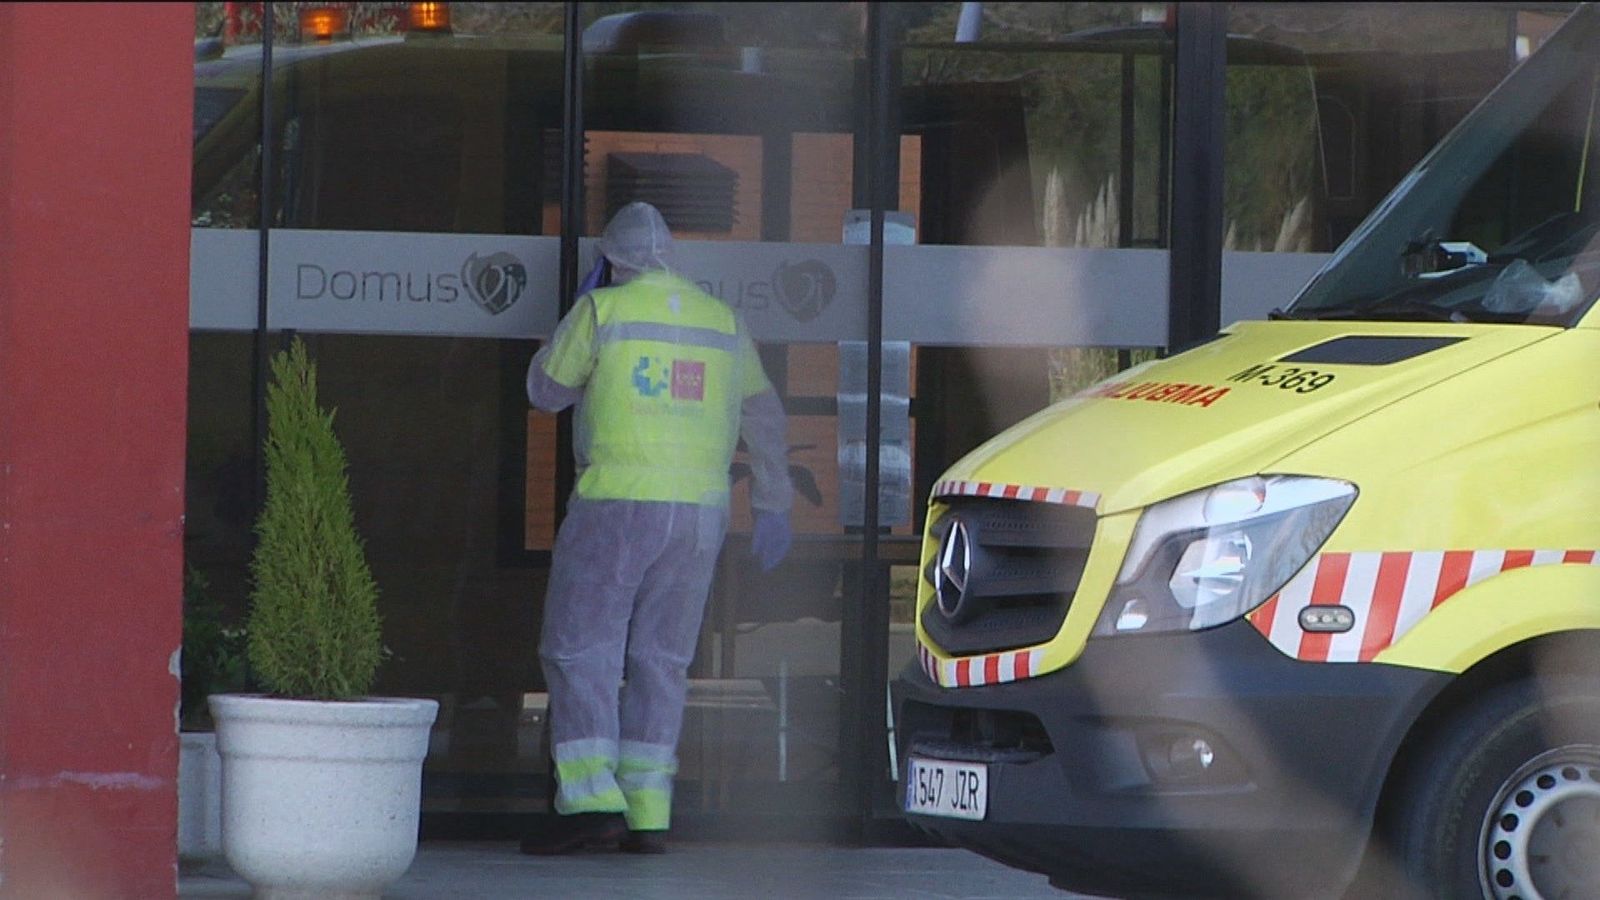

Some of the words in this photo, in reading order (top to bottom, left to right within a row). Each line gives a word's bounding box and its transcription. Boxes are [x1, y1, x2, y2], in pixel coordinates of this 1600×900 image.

[1226, 364, 1336, 394] M-369
[913, 766, 944, 808] 1547
[951, 769, 980, 811] JZR
